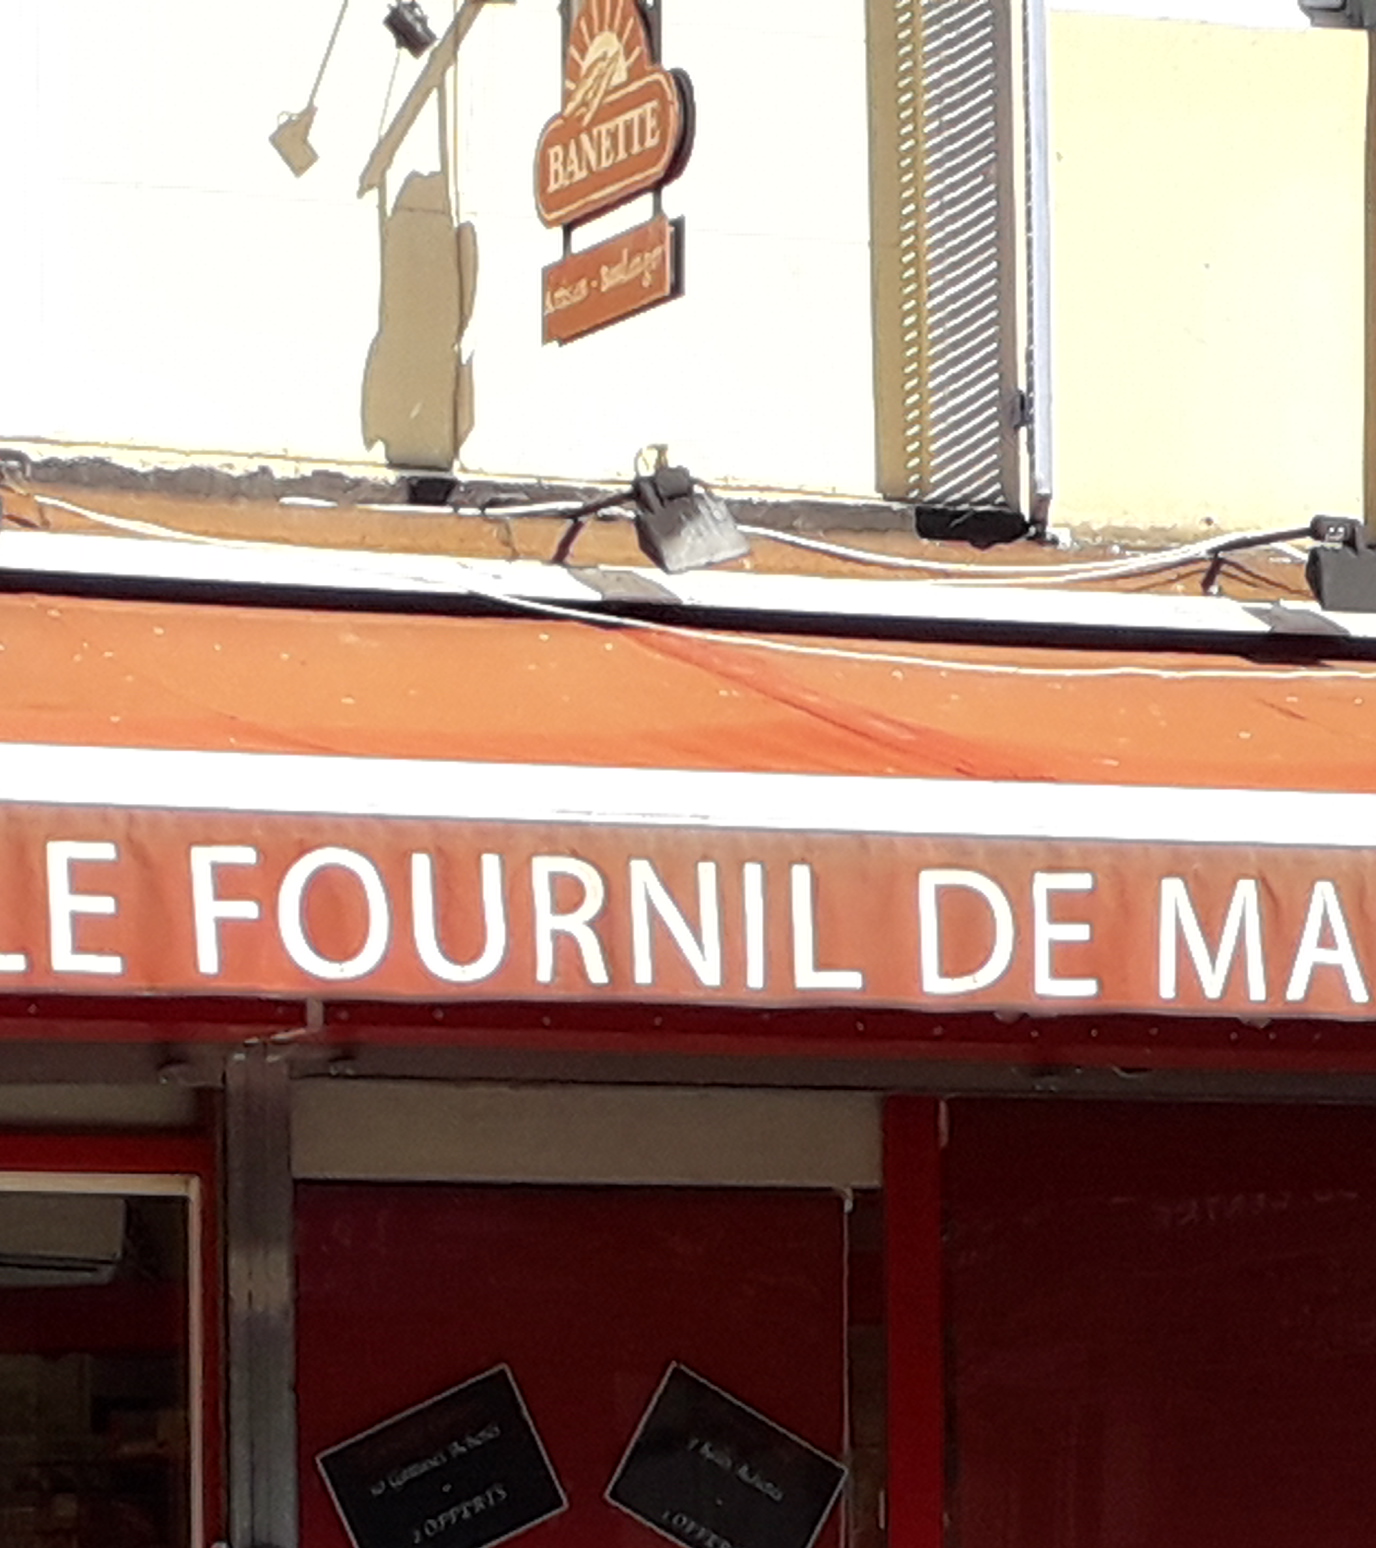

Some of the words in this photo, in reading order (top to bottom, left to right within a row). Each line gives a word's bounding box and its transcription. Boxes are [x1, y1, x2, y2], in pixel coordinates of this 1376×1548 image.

[546, 99, 661, 194] BANETTE
[190, 844, 864, 991] FOURNIL
[916, 867, 1099, 998] DE
